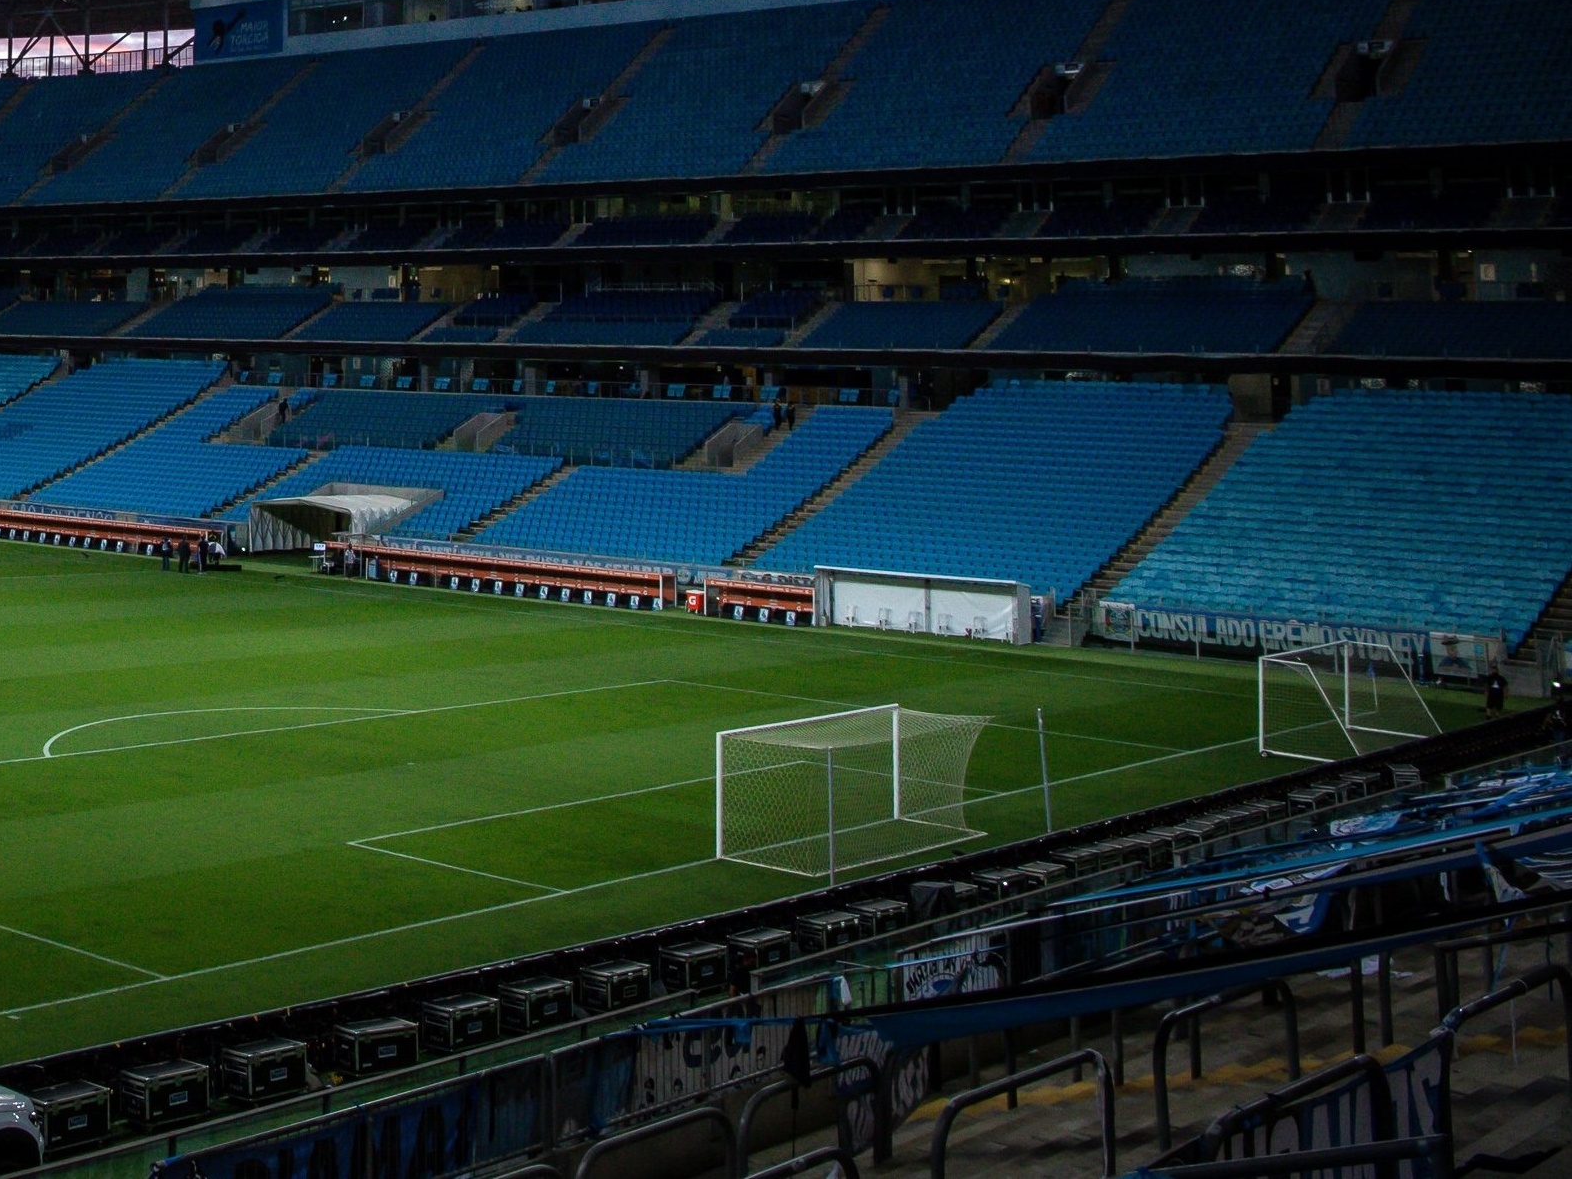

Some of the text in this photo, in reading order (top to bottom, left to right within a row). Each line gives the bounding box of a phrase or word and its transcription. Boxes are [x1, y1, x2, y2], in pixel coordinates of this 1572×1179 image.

[688, 596, 697, 606] G
[1138, 609, 1257, 649] CONSULADO
[1338, 626, 1427, 666] SYDNEY
